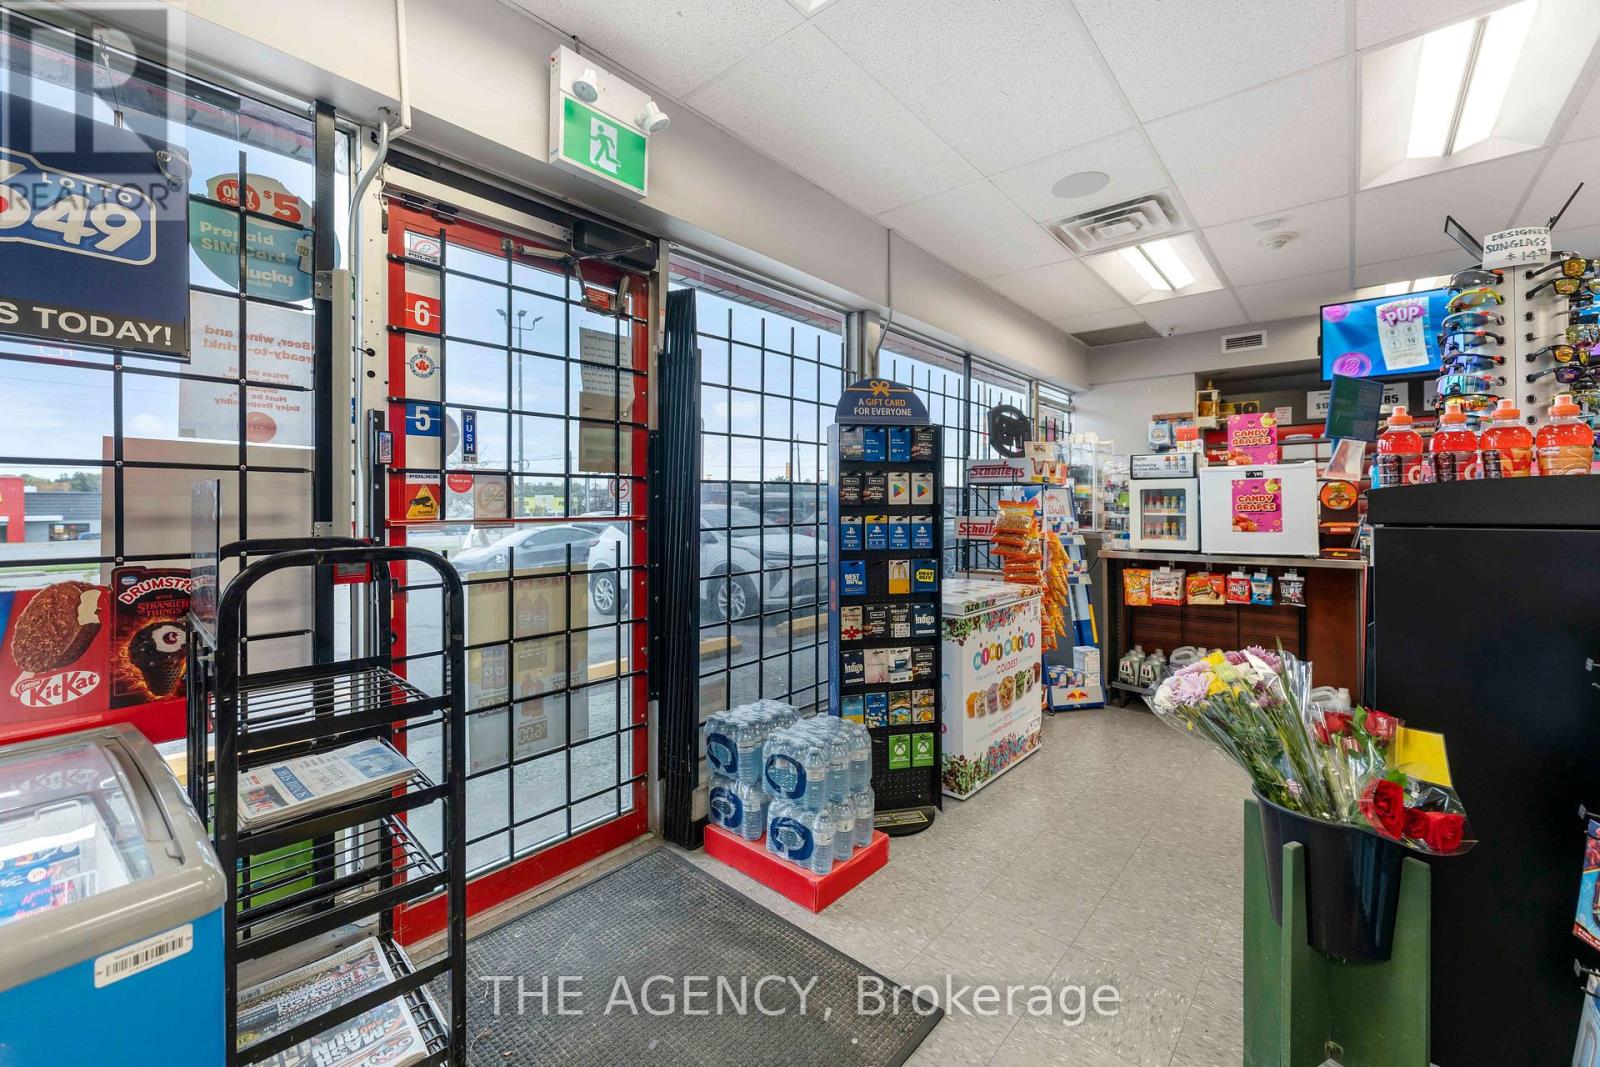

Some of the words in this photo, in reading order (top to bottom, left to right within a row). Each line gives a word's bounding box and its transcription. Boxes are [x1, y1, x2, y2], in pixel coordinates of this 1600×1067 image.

[42, 172, 133, 203] LOTTO
[222, 185, 254, 203] ONY
[201, 238, 237, 254] SIM
[246, 246, 287, 262] Card
[1485, 237, 1547, 254] SUNGLASS
[414, 300, 430, 326] 6
[1385, 306, 1420, 325] POP
[32, 306, 172, 346] TODAY!
[858, 398, 864, 406] A
[866, 398, 882, 406] GIFT
[885, 398, 906, 407] CARD
[414, 405, 431, 431] 5
[854, 407, 869, 415] FOR
[872, 407, 912, 416] EVERYONE
[465, 415, 474, 452] PUSH
[1232, 437, 1271, 446] GRAPES
[1234, 429, 1268, 437] CANDY
[1236, 503, 1277, 512] GRAPES
[1238, 495, 1274, 503] CANDY
[137, 599, 190, 613] STRANGER
[145, 608, 183, 617] THINGS
[915, 613, 935, 625] Indigo
[974, 643, 1004, 671] MINI
[1004, 632, 1036, 656] MELTS
[844, 661, 863, 673] Indigo
[29, 670, 98, 707] KitKat
